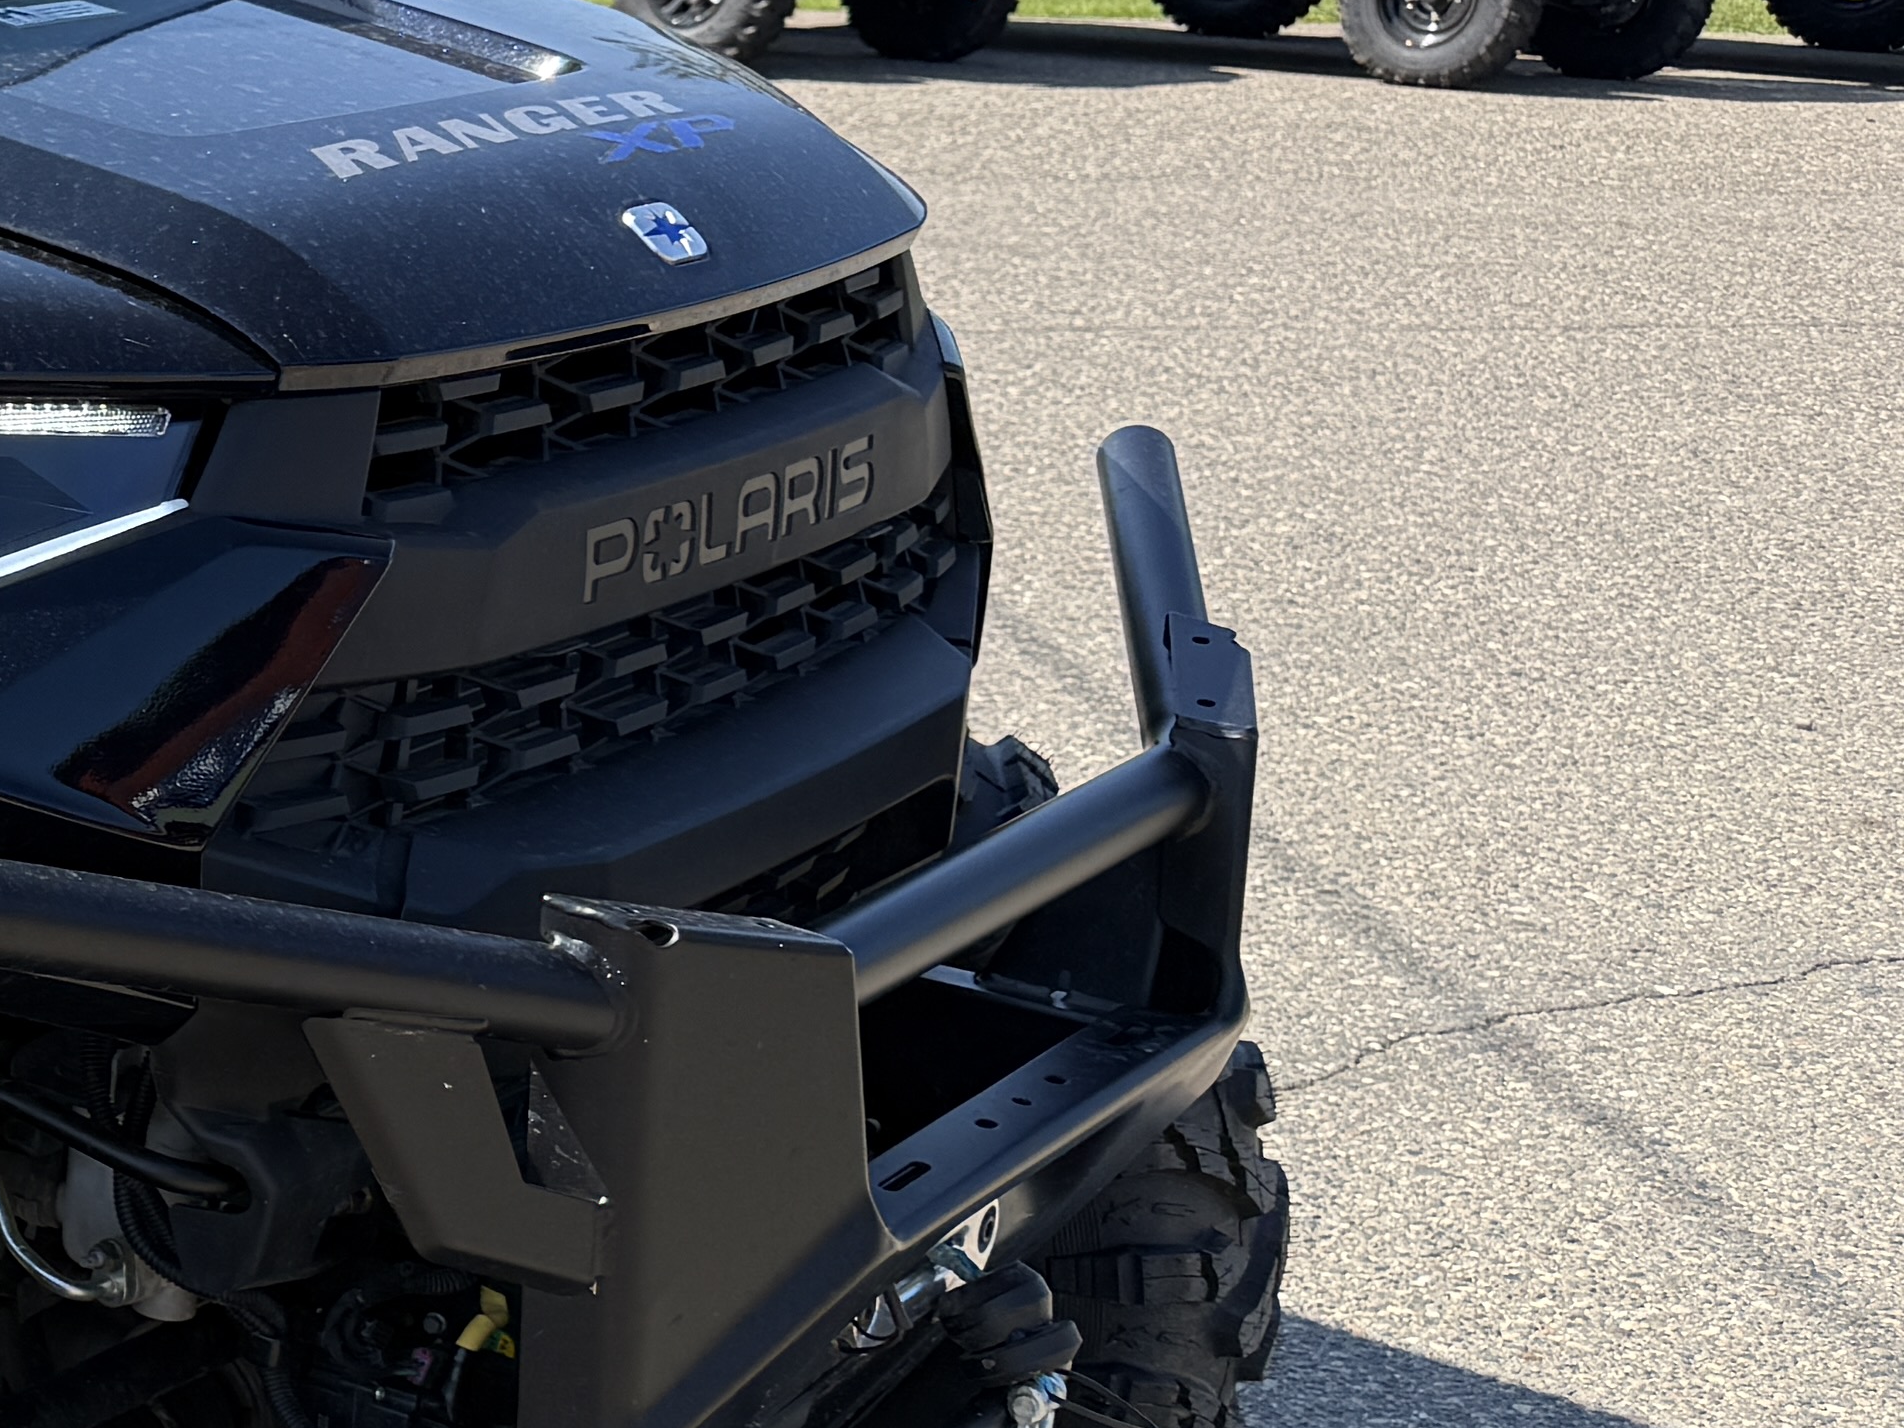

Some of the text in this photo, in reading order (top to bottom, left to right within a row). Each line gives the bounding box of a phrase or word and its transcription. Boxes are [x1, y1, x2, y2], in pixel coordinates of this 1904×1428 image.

[309, 89, 685, 180] RANGER
[586, 112, 735, 164] XP
[583, 434, 875, 605] POLARIS
